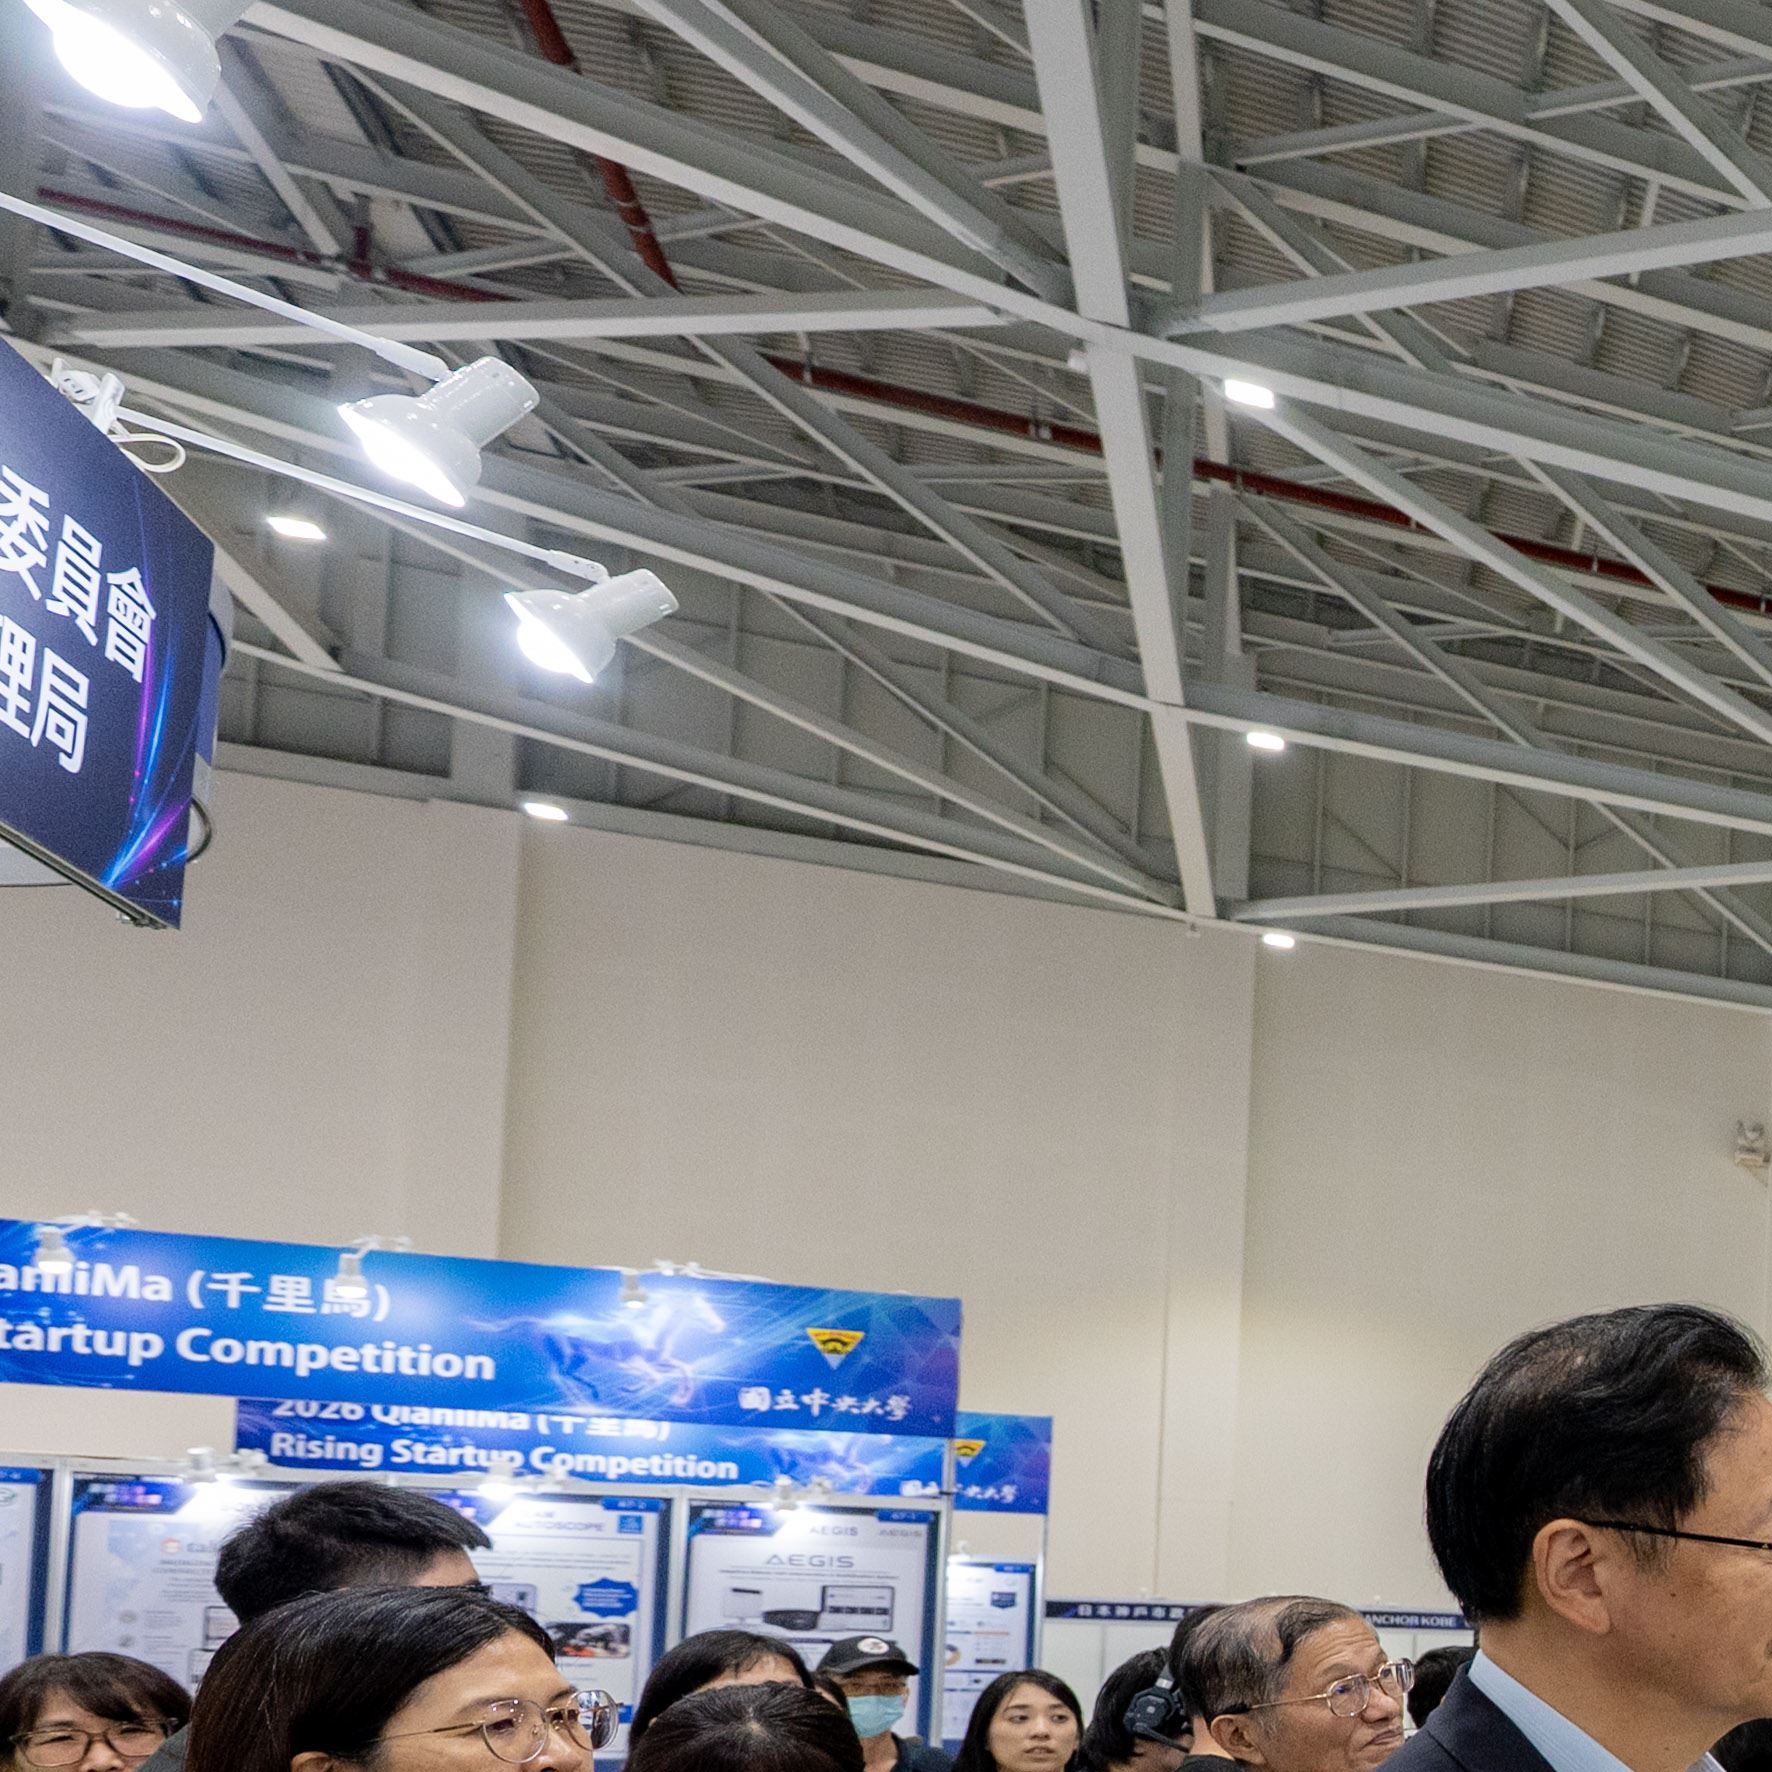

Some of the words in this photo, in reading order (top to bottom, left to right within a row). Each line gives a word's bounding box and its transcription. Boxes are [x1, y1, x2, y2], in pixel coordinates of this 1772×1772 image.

[0, 462, 157, 685] 委員會
[176, 1326, 496, 1381] Competition
[271, 1400, 365, 1422] 2026
[738, 1386, 911, 1422] 國立中央大學
[270, 1431, 383, 1468] Rising
[389, 1437, 525, 1470] Startup
[529, 1446, 739, 1481] Competition
[808, 1524, 860, 1538] AEGIS
[765, 1554, 855, 1570] AEGIS
[1421, 1616, 1457, 1629] KOBE
